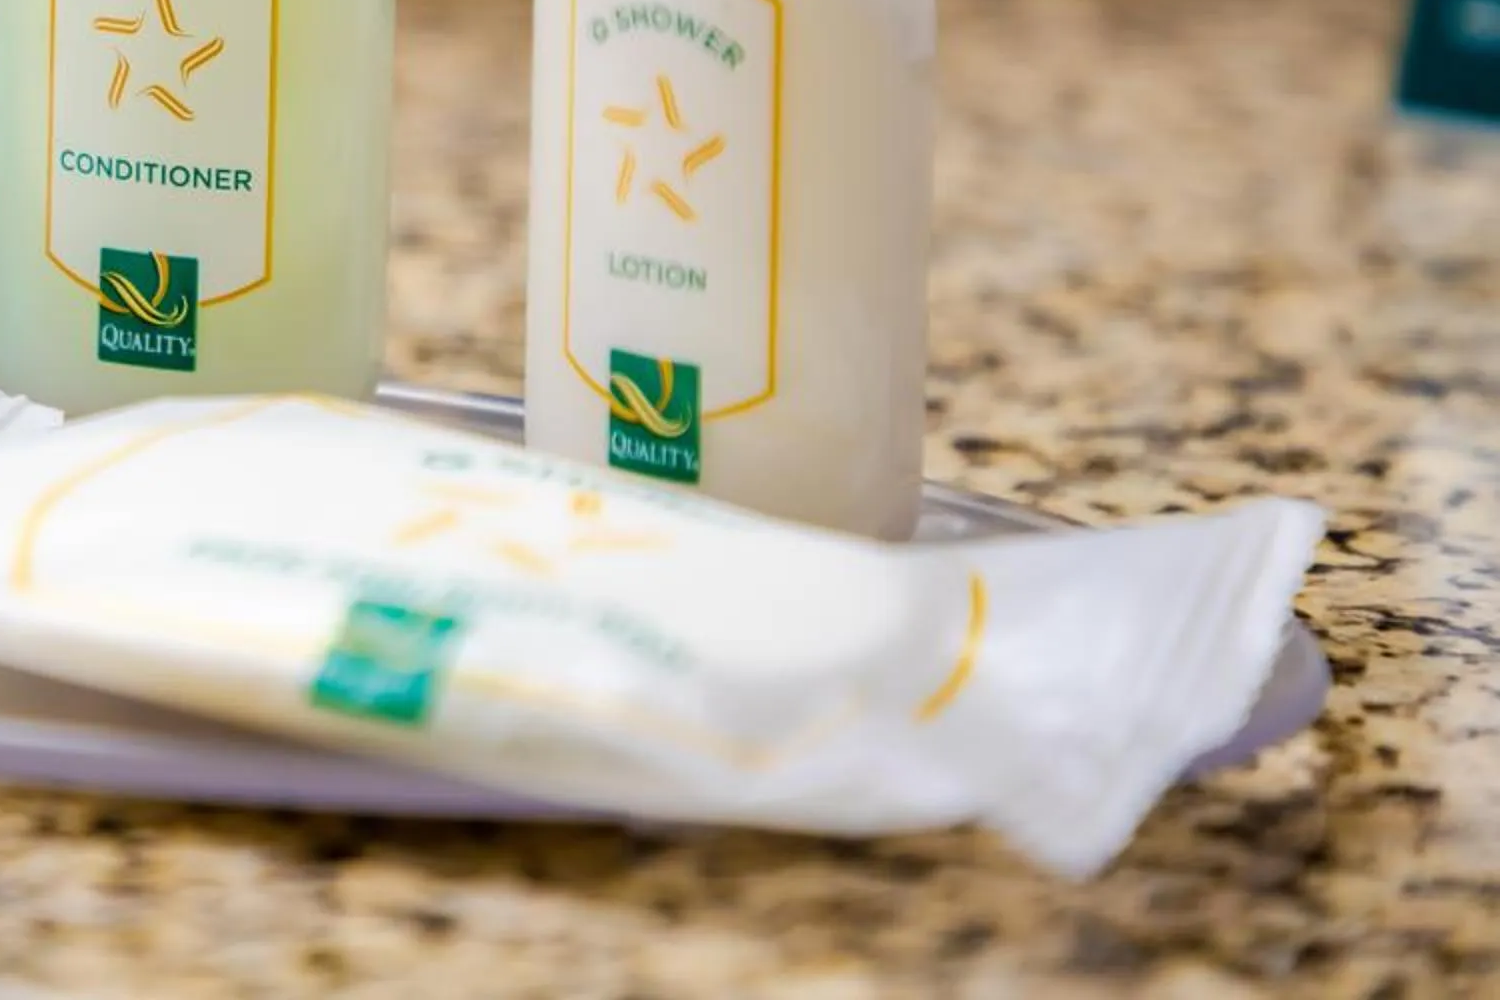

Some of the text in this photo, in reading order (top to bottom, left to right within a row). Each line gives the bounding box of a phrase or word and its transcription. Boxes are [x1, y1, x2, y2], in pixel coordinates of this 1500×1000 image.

[613, 3, 746, 71] SHOWER
[59, 149, 253, 193] CONDITIONER
[608, 250, 708, 293] LOTION
[101, 322, 193, 358] QUALITY
[611, 430, 696, 471] QUALITY
